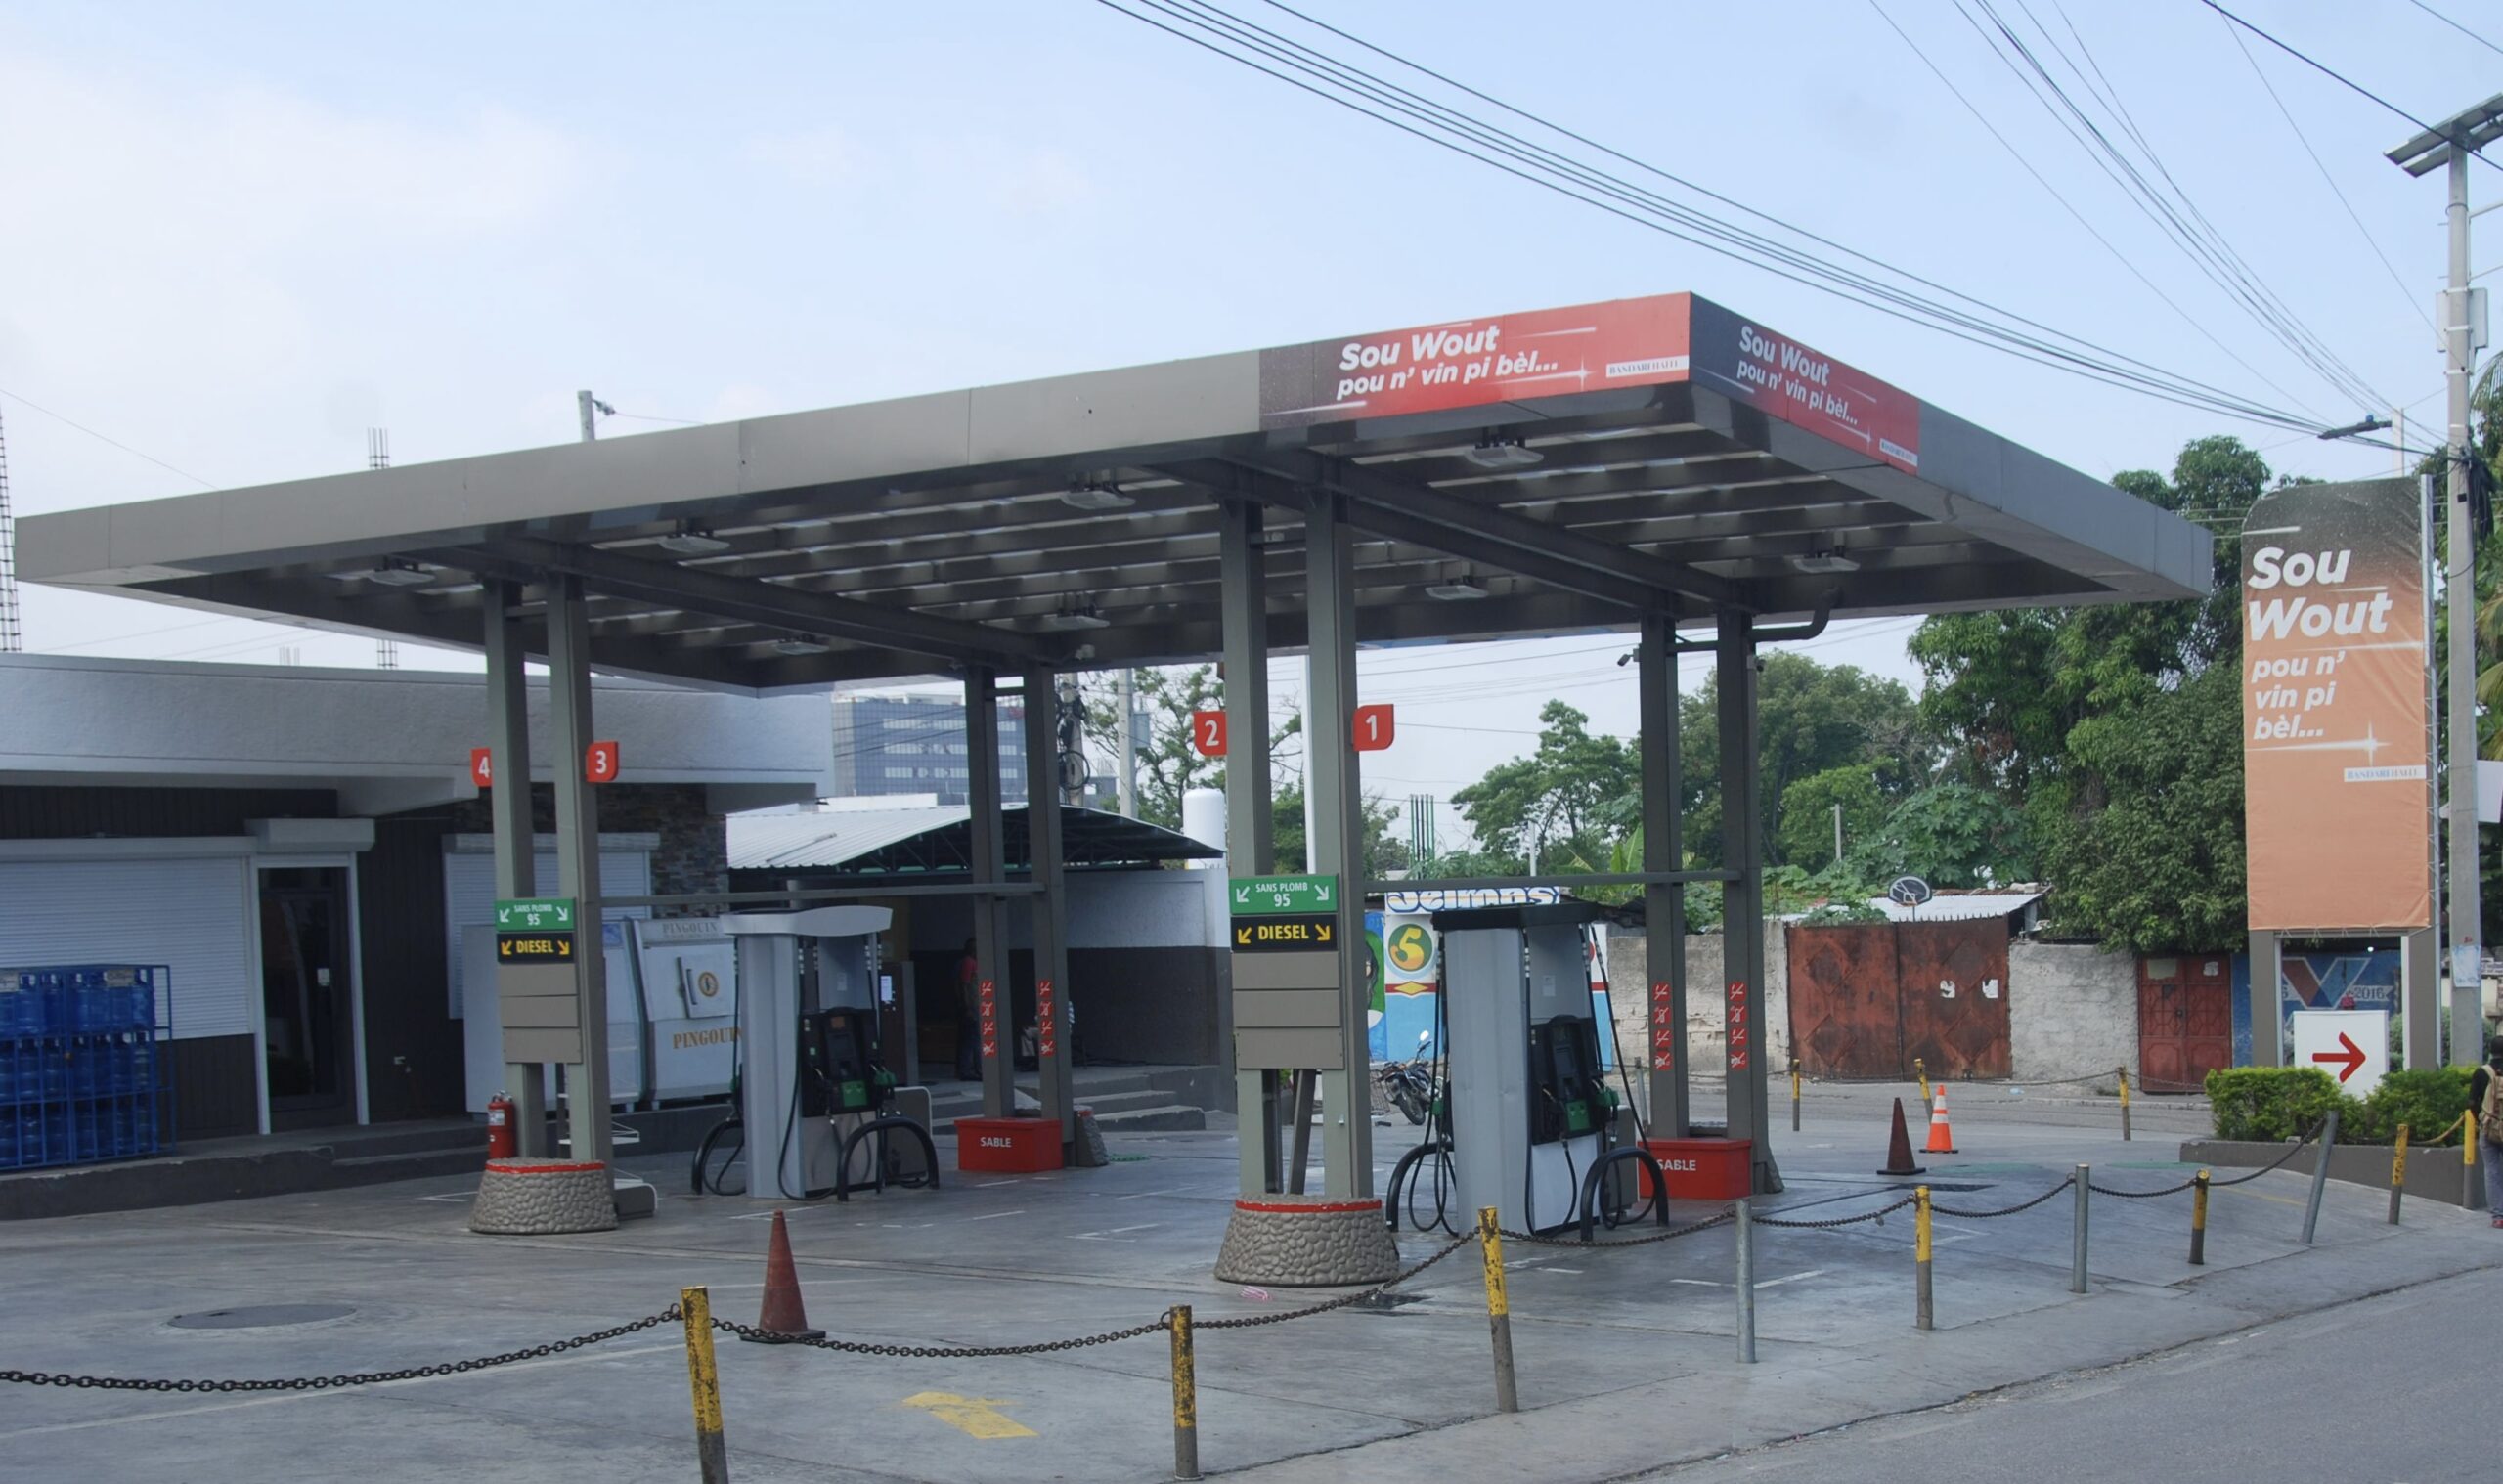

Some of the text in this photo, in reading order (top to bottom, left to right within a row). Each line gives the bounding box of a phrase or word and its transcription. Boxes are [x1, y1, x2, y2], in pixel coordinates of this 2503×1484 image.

[1339, 325, 1501, 371] Sou Wout
[1739, 326, 1830, 386] Sou Wout
[1337, 374, 1384, 401] pou
[1422, 362, 1458, 385] vin
[1463, 356, 1491, 384] pi
[1495, 350, 1558, 376] bèl...
[1736, 360, 1765, 384] pou
[1785, 378, 1806, 403] vin
[1809, 390, 1824, 411] pi
[2247, 546, 2351, 590] Sou
[2249, 592, 2393, 642] Wout
[2251, 652, 2309, 683] pou
[2255, 681, 2337, 711] vin pi
[1205, 720, 1219, 747] 2
[1366, 714, 1378, 742] 1
[2253, 715, 2324, 740] bèl...
[478, 756, 490, 779] 4
[595, 750, 607, 774] 3
[1255, 882, 1308, 893] SANS PLOMB
[1274, 894, 1291, 908] 95
[526, 913, 541, 926] 95
[1258, 925, 1310, 940] DIESEL
[516, 940, 554, 953] DIESEL
[1389, 926, 1426, 971] 5
[2353, 985, 2387, 999] 2016
[980, 1137, 1012, 1148] SABLE
[1656, 1159, 1696, 1171] SABLE
